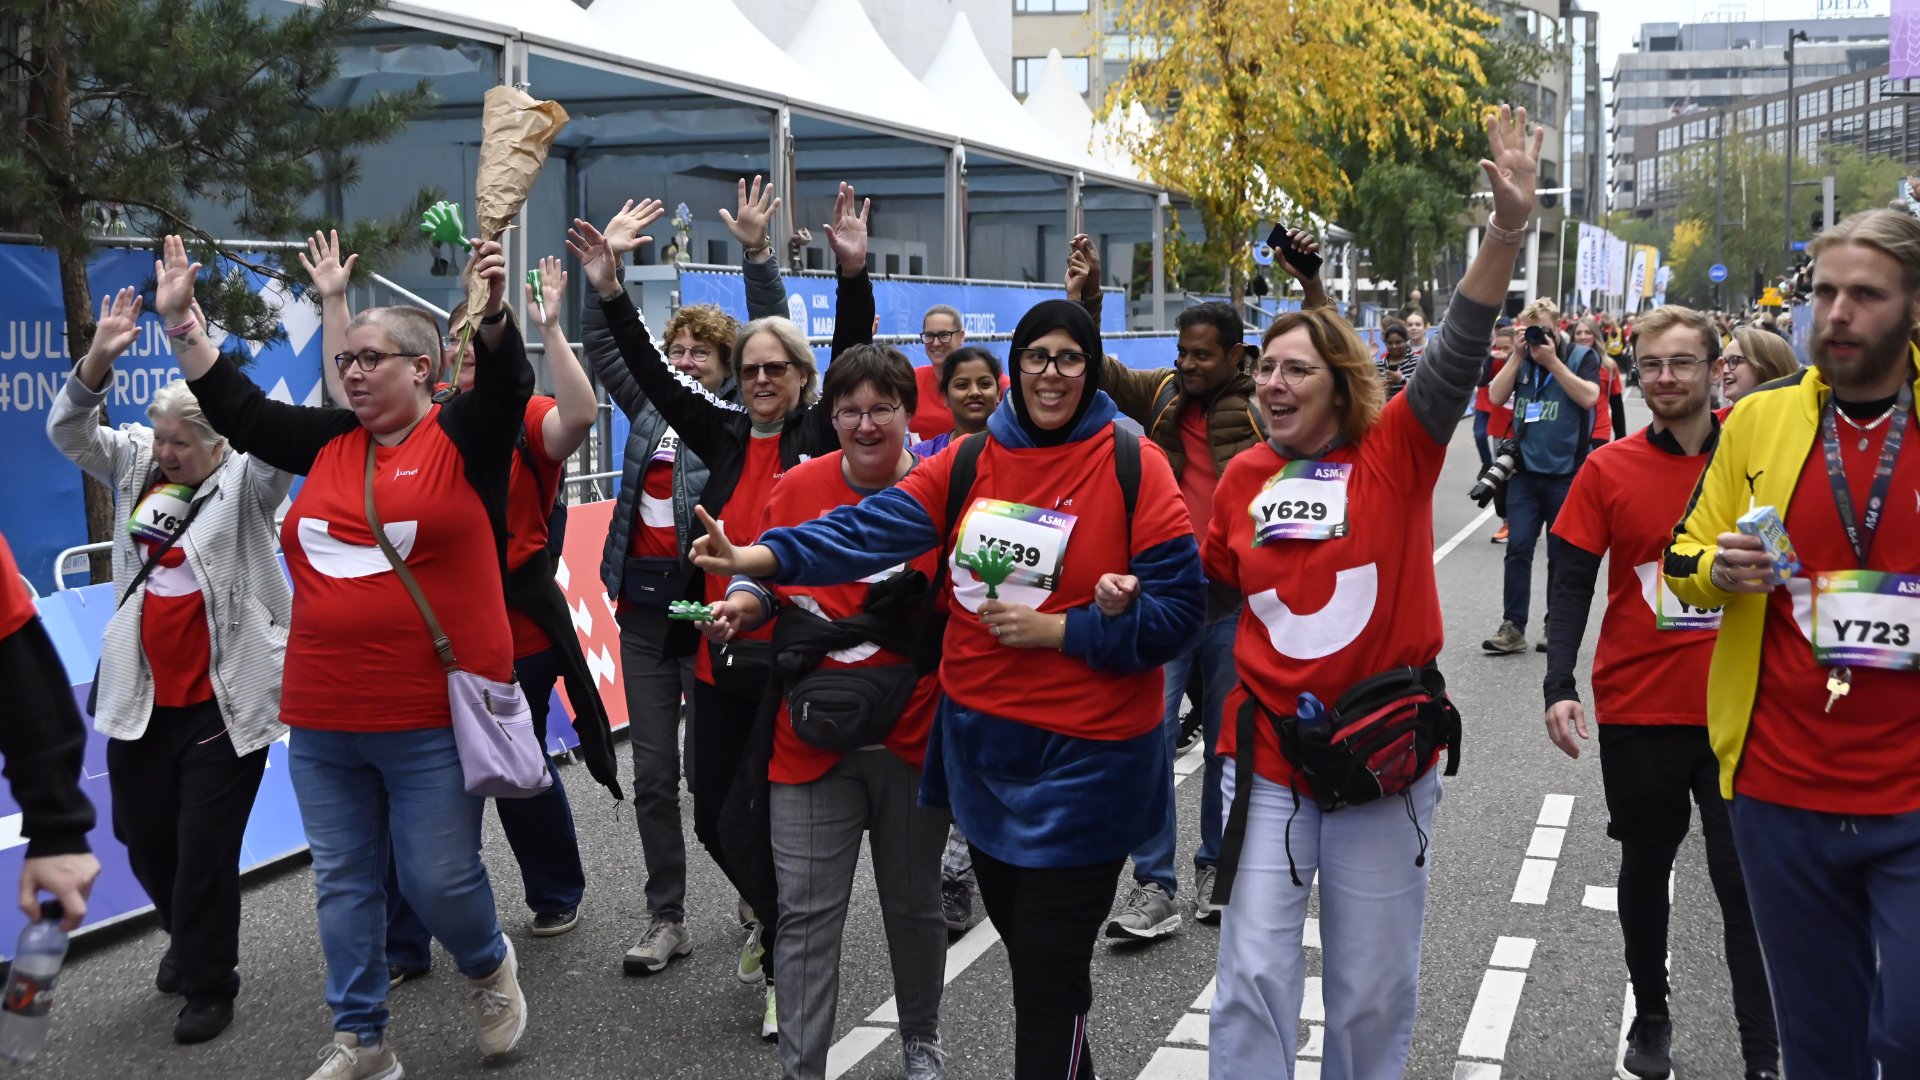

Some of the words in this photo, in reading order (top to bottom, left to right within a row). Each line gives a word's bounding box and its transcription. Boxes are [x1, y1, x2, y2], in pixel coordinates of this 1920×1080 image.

[1820, 0, 1869, 10] DELA
[812, 294, 829, 309] ASML
[1315, 468, 1345, 478] ASML
[1261, 500, 1327, 523] Y629
[1038, 514, 1067, 528] ASML
[1865, 510, 1879, 530] PSV
[1832, 619, 1910, 646] Y723
